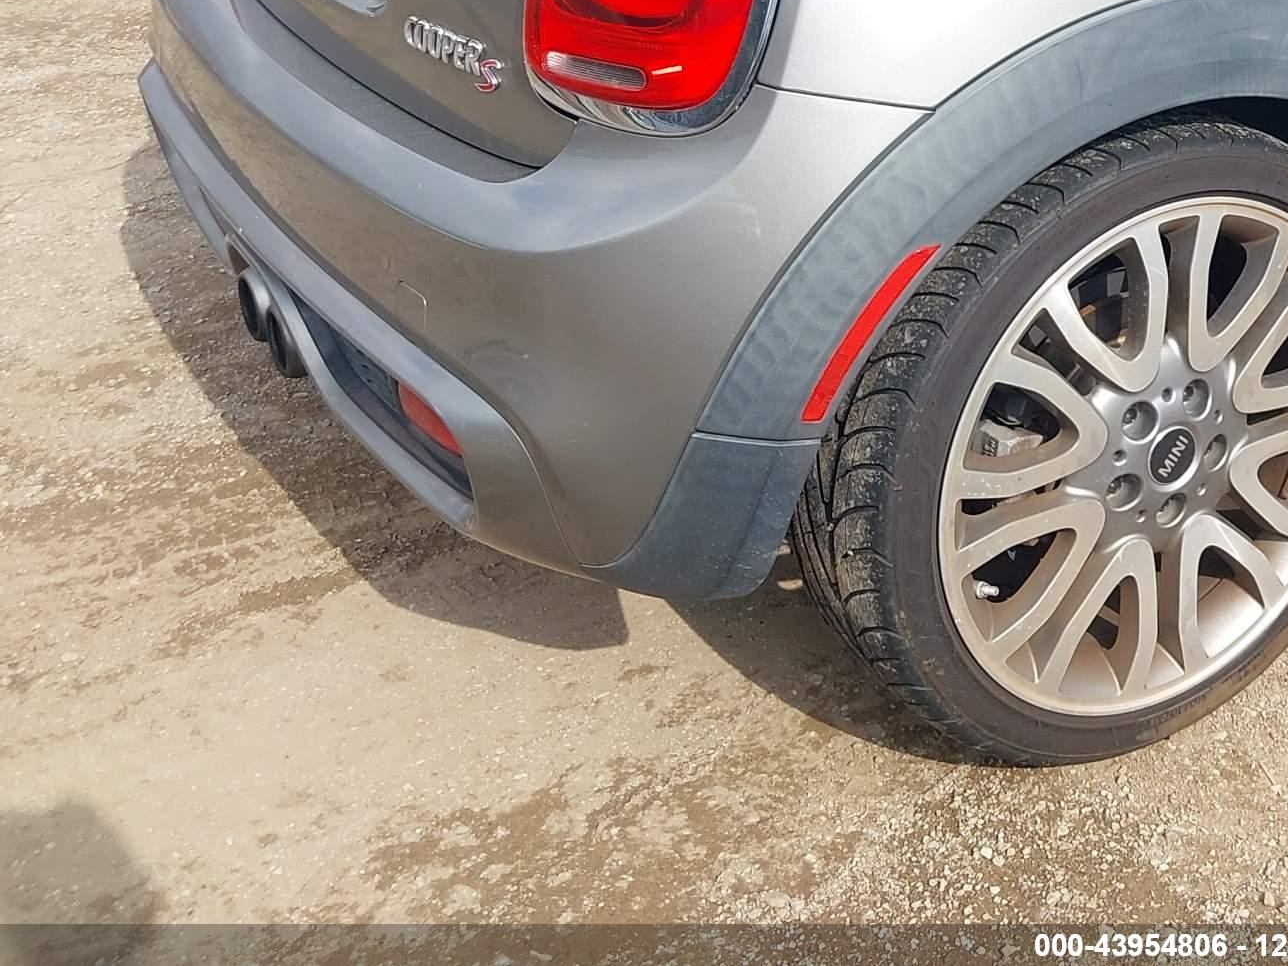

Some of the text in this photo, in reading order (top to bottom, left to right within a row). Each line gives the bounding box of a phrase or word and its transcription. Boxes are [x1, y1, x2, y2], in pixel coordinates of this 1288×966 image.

[404, 16, 503, 92] COOPER S
[1158, 435, 1189, 477] MINI
